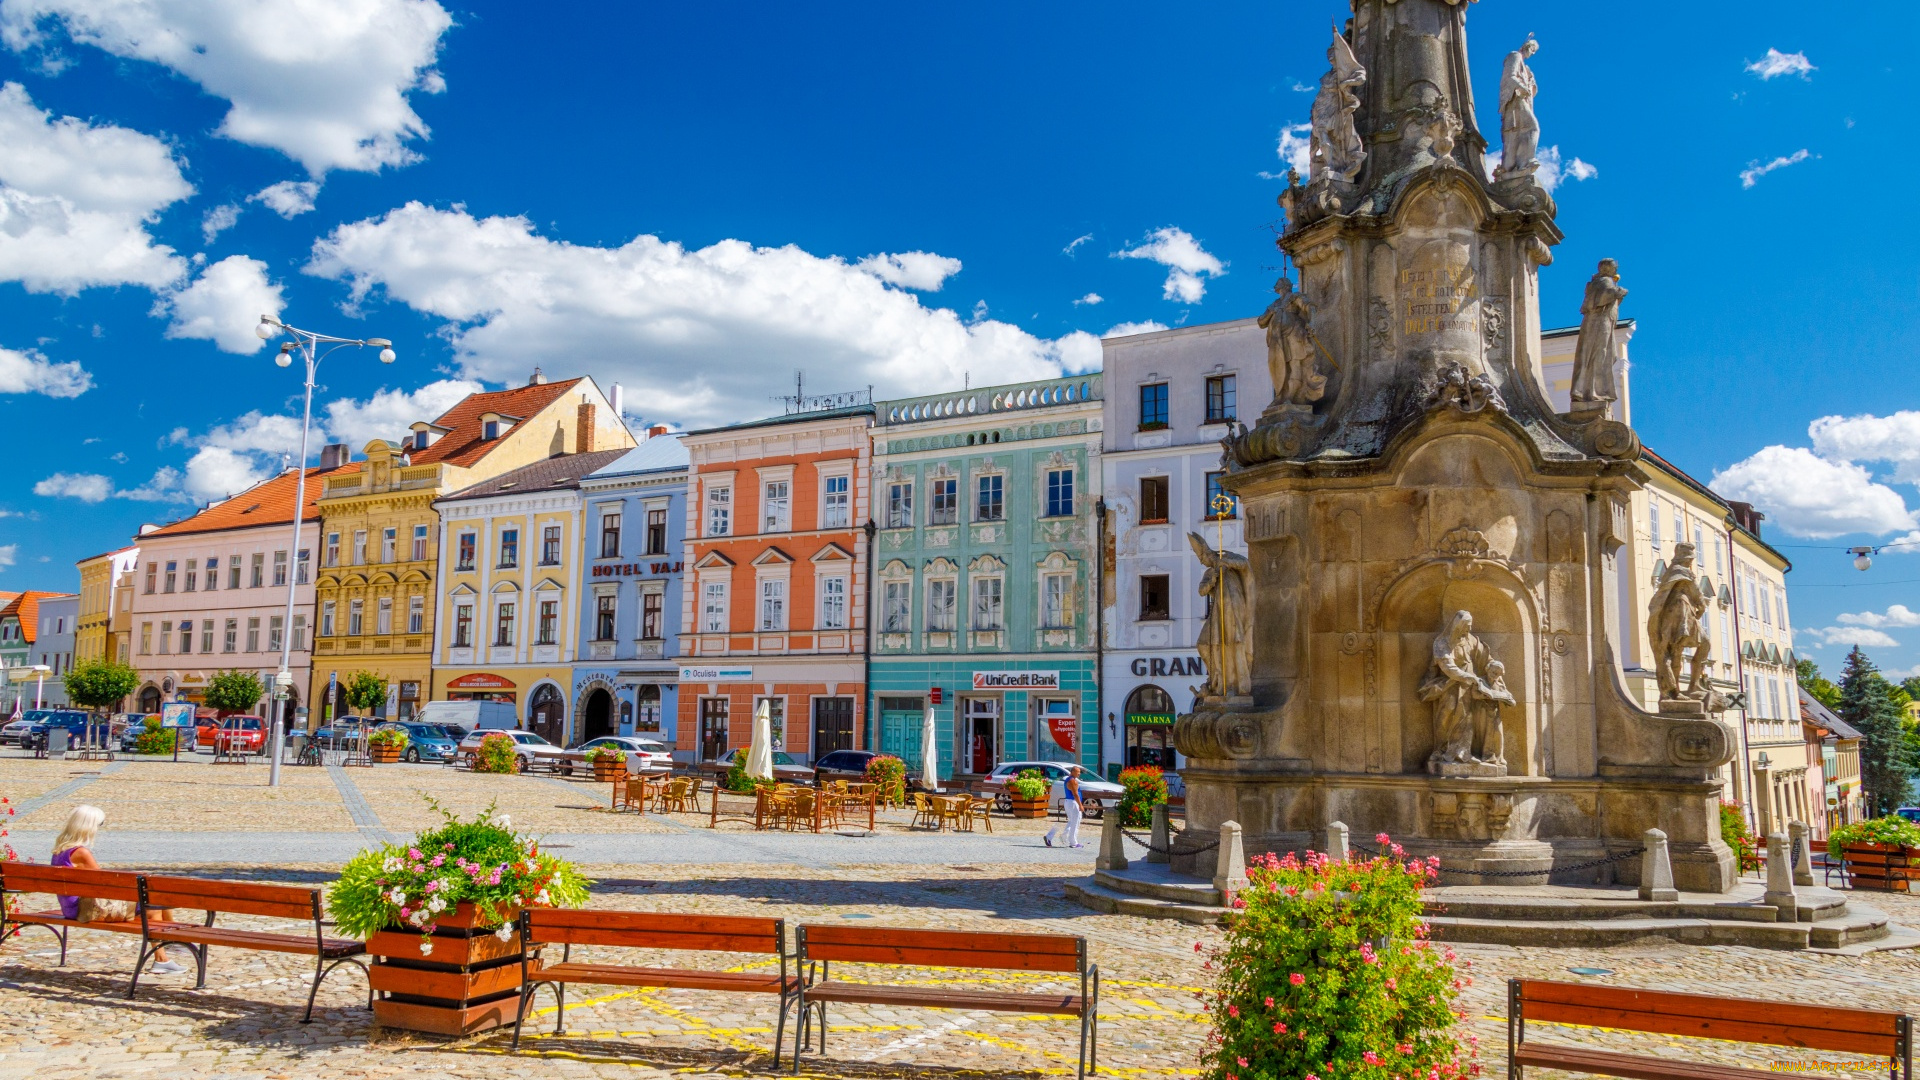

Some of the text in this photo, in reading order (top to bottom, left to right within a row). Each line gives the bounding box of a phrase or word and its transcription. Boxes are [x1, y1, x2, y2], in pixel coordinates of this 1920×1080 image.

[592, 561, 684, 577] HOTEL VAJ
[1130, 656, 1209, 677] GRAN
[692, 669, 717, 678] Oculista
[985, 673, 1057, 686] UniCredit Bank
[1131, 715, 1172, 724] VINÁRNA
